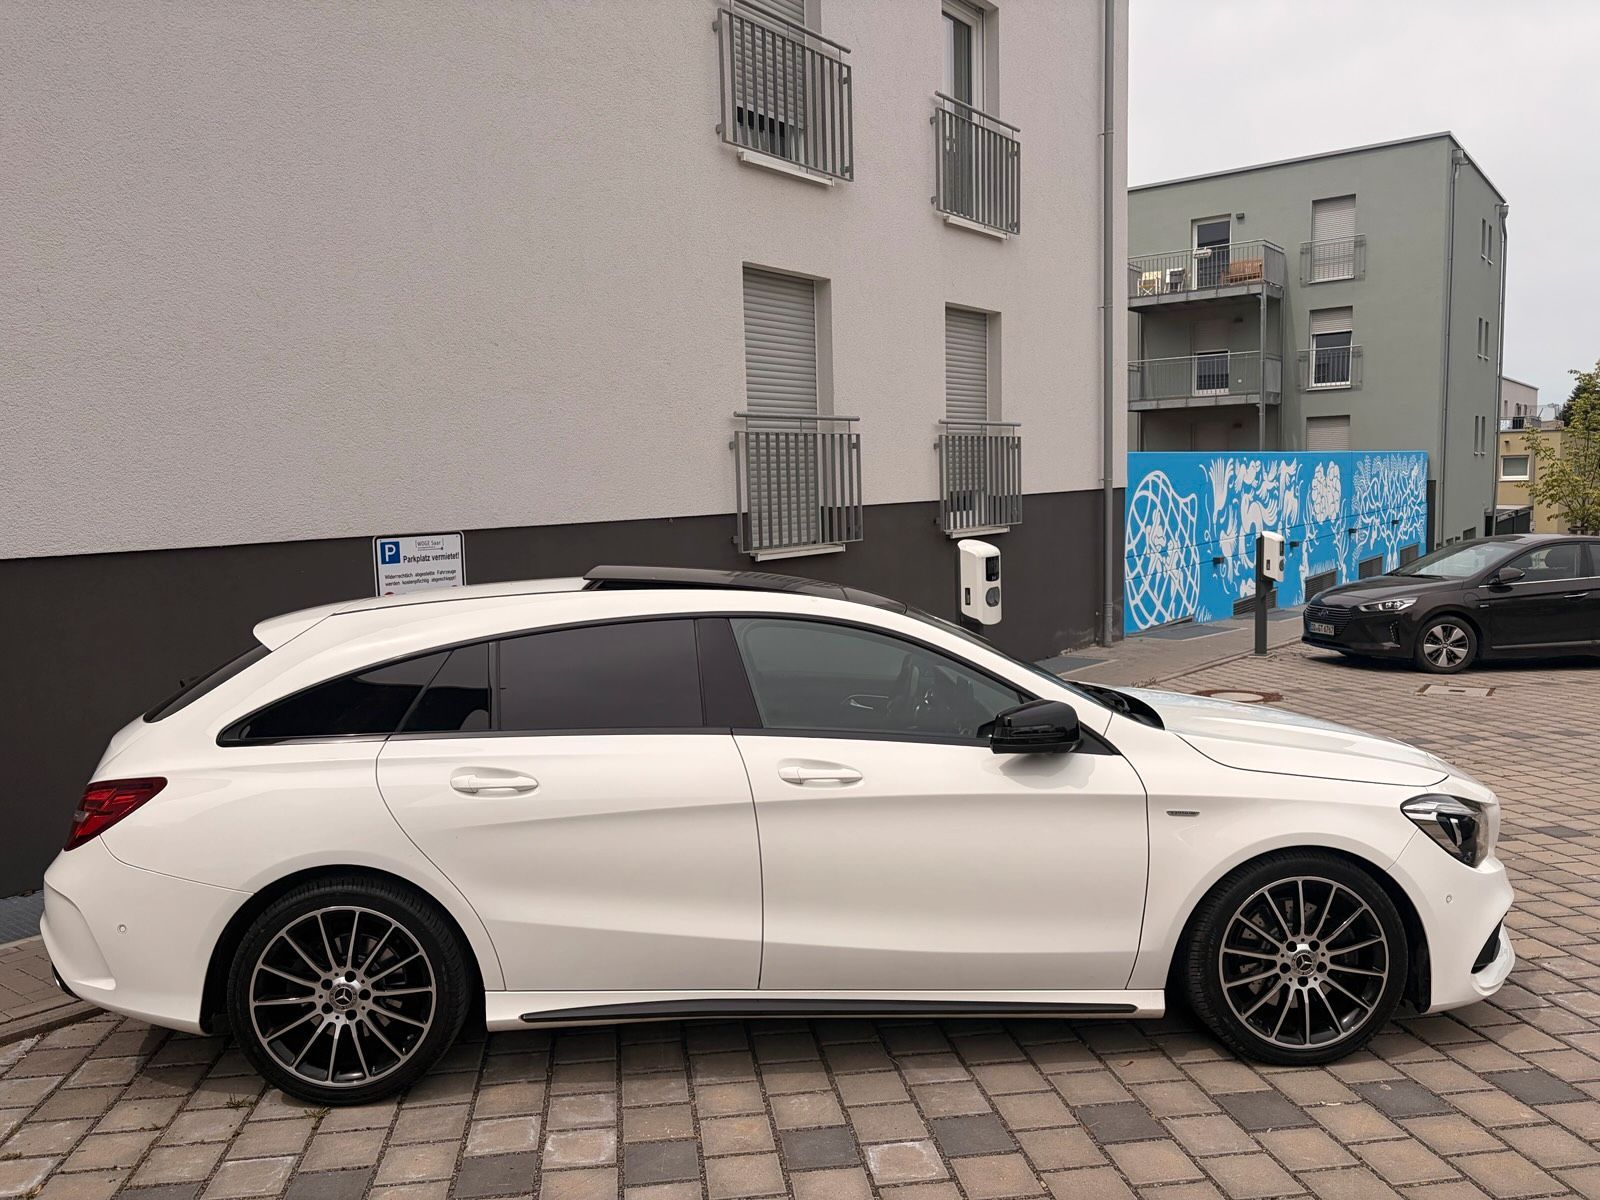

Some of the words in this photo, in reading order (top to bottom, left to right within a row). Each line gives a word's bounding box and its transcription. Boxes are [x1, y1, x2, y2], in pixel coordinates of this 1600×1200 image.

[385, 544, 396, 561] P
[403, 555, 430, 564] Parkplatz
[432, 552, 459, 561] vermietet!
